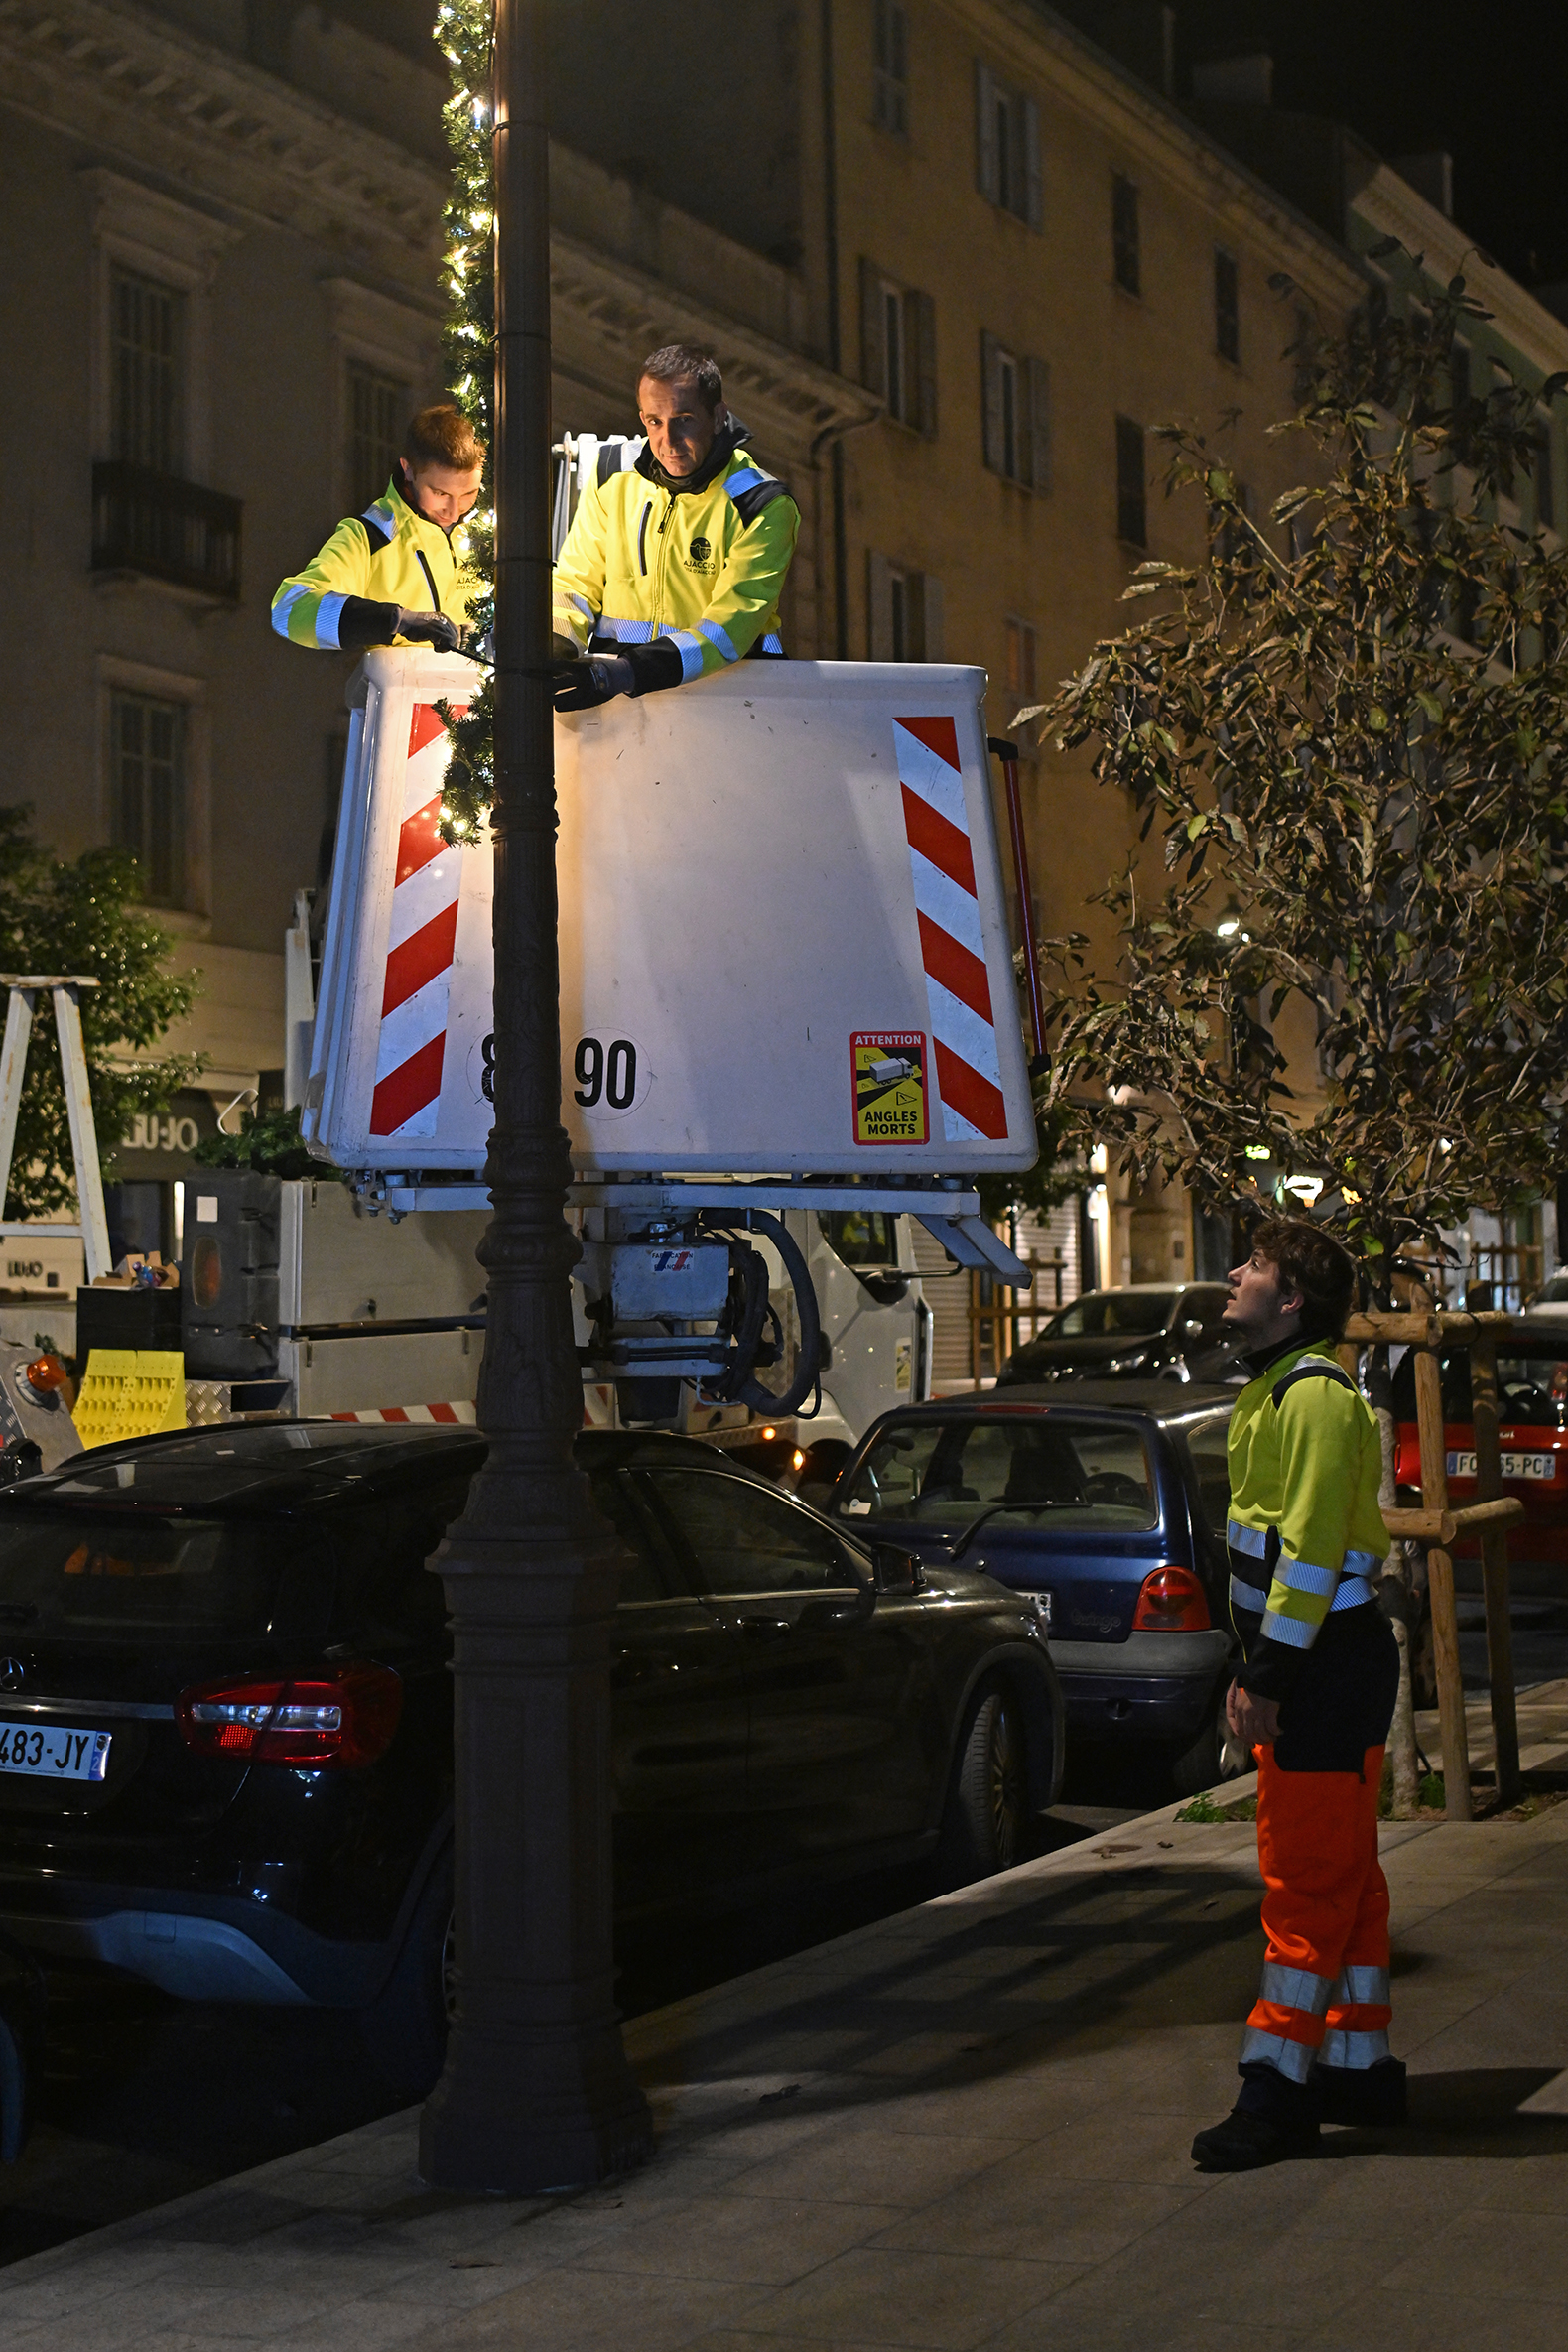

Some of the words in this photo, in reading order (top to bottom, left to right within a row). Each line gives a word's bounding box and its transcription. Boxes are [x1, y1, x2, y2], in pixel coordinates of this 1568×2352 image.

[683, 560, 716, 570] AJACCIO
[855, 1035, 922, 1045] ATTENTION
[574, 1037, 637, 1110] 90
[864, 1111, 918, 1122] ANGLES
[868, 1124, 916, 1135] MORTS
